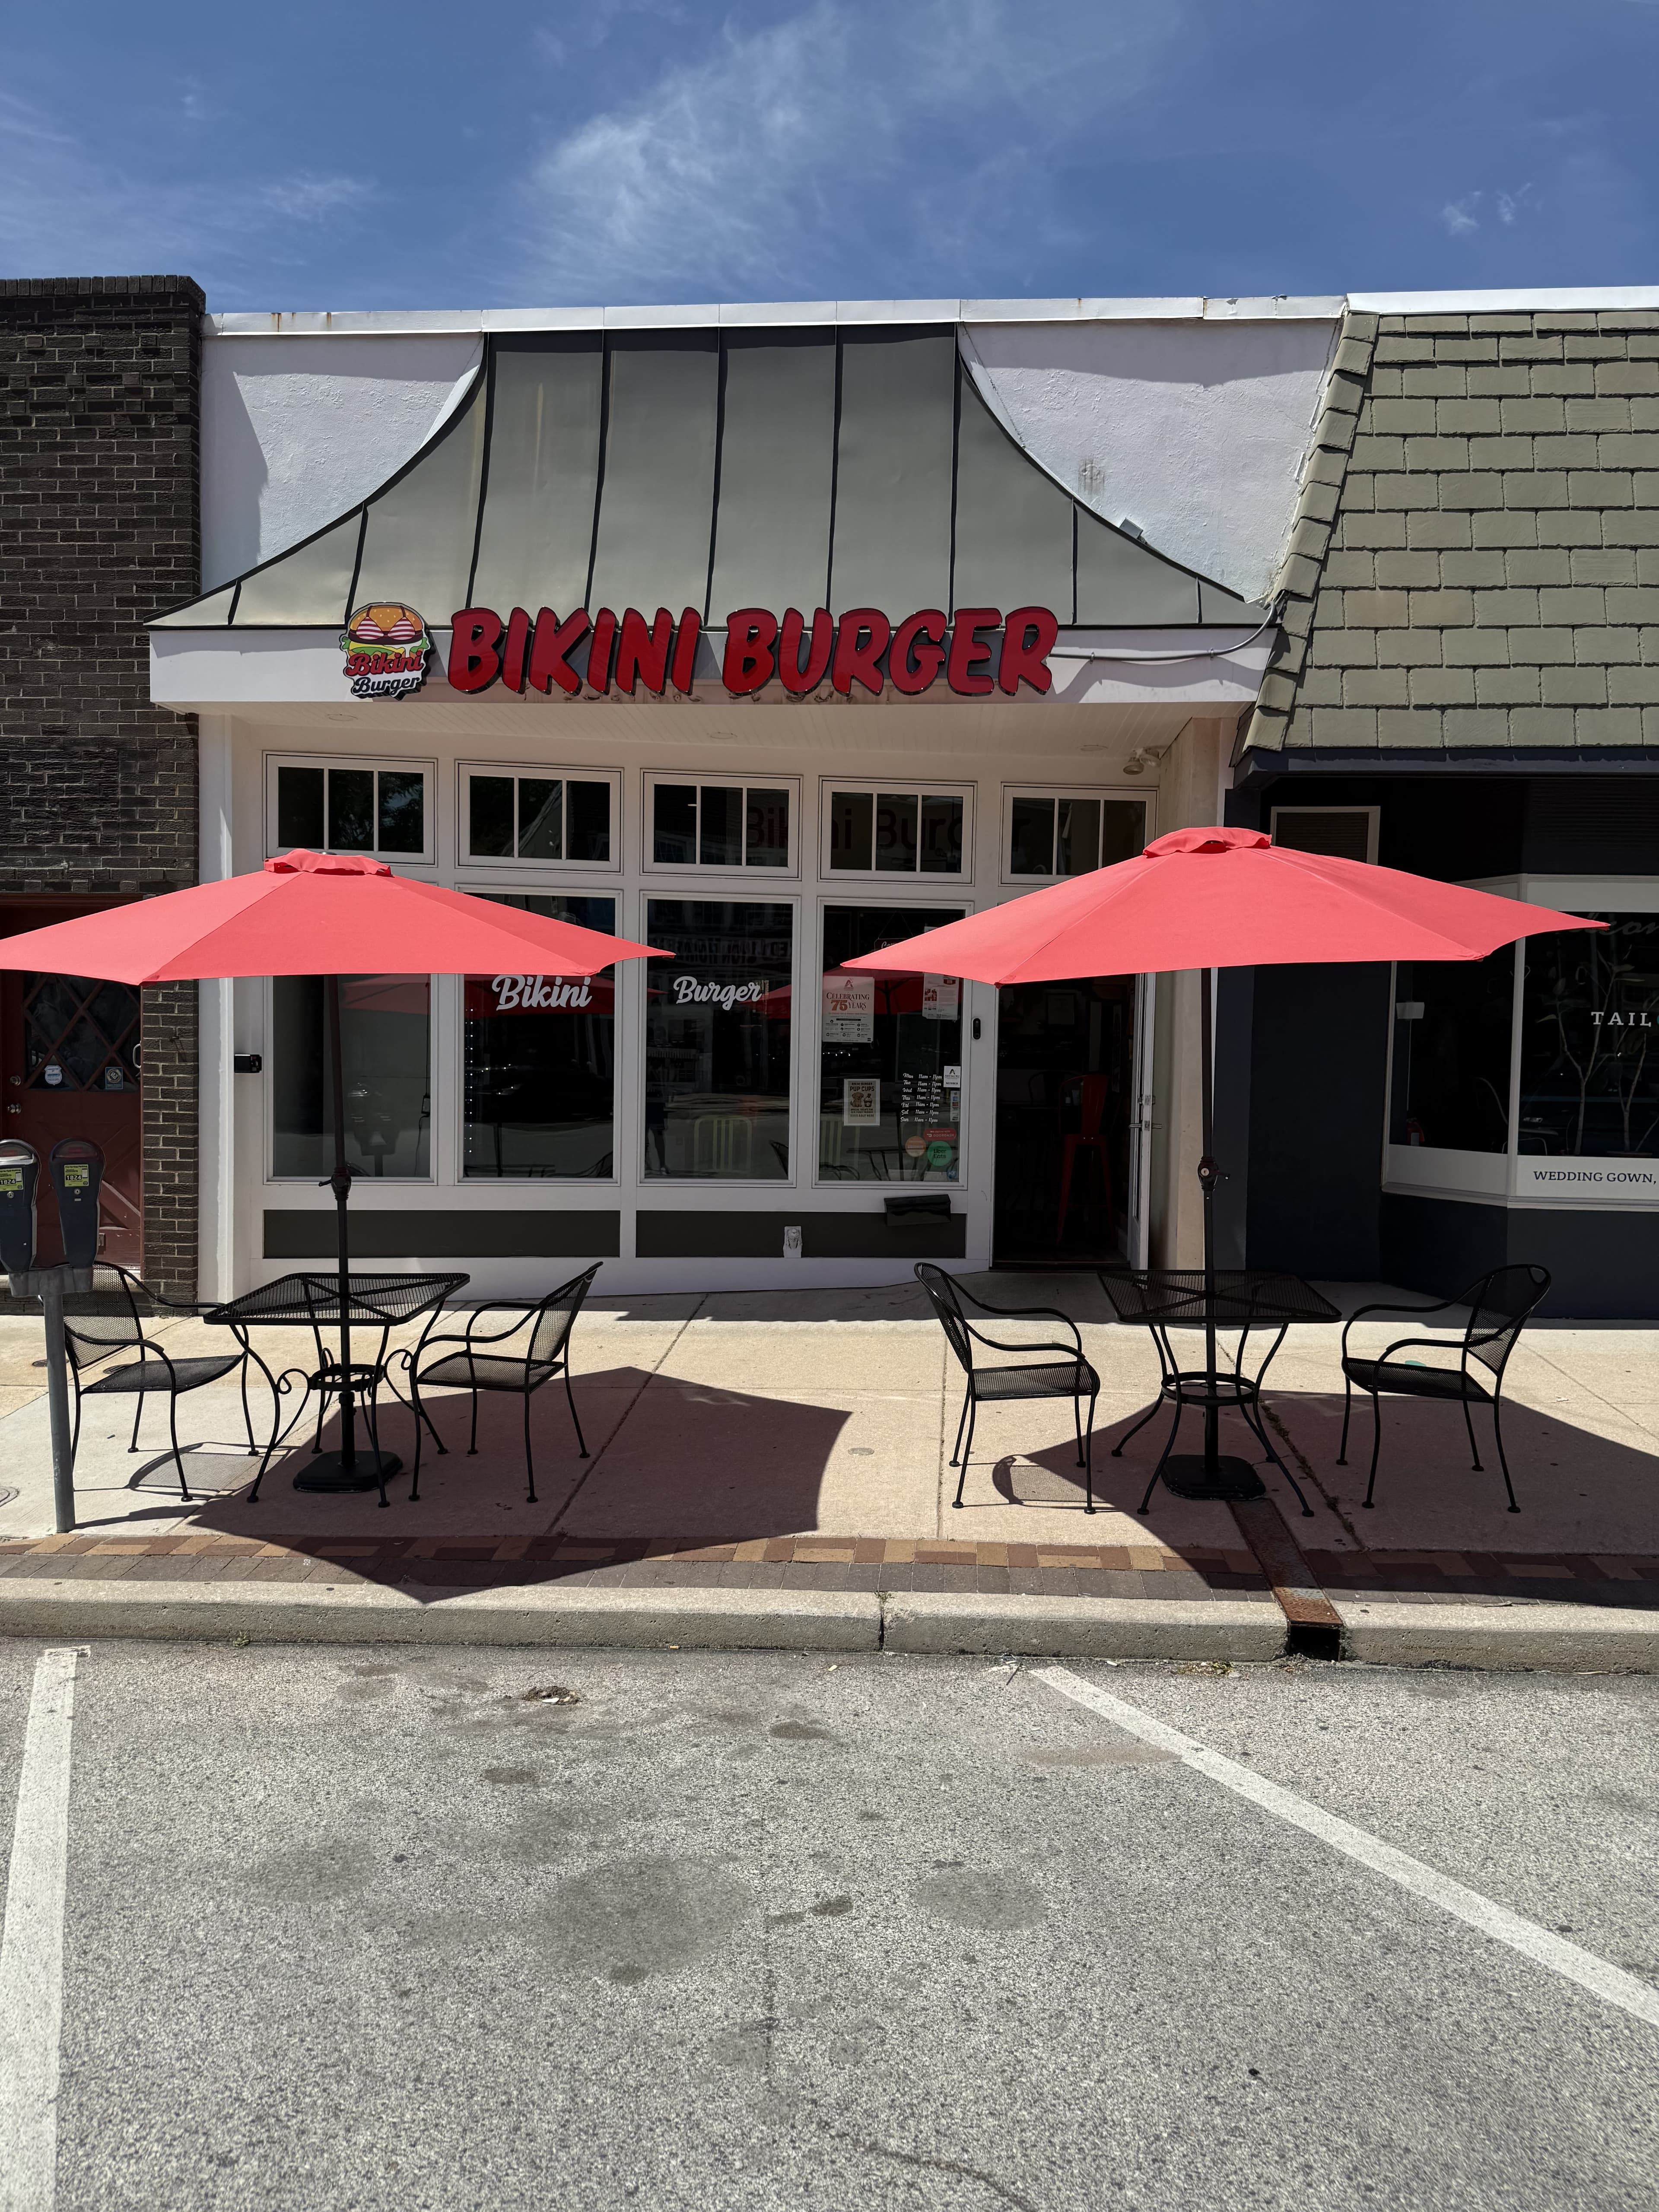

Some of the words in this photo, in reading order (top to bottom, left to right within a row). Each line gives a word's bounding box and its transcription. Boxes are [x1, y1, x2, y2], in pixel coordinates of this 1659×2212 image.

[448, 607, 702, 695] BIKINI
[722, 606, 1058, 696] BURGER
[346, 650, 424, 677] Bikini
[353, 676, 421, 696] Burger
[491, 975, 592, 1011] Bikini
[673, 975, 762, 1011] Burger
[826, 992, 869, 1001] CELEBRATING
[831, 999, 848, 1011] 75
[848, 1002, 868, 1011] YEARS
[1591, 1011, 1659, 1027] TAIL
[1533, 1171, 1604, 1182] WEDDING
[1606, 1172, 1658, 1185] GOWN,
